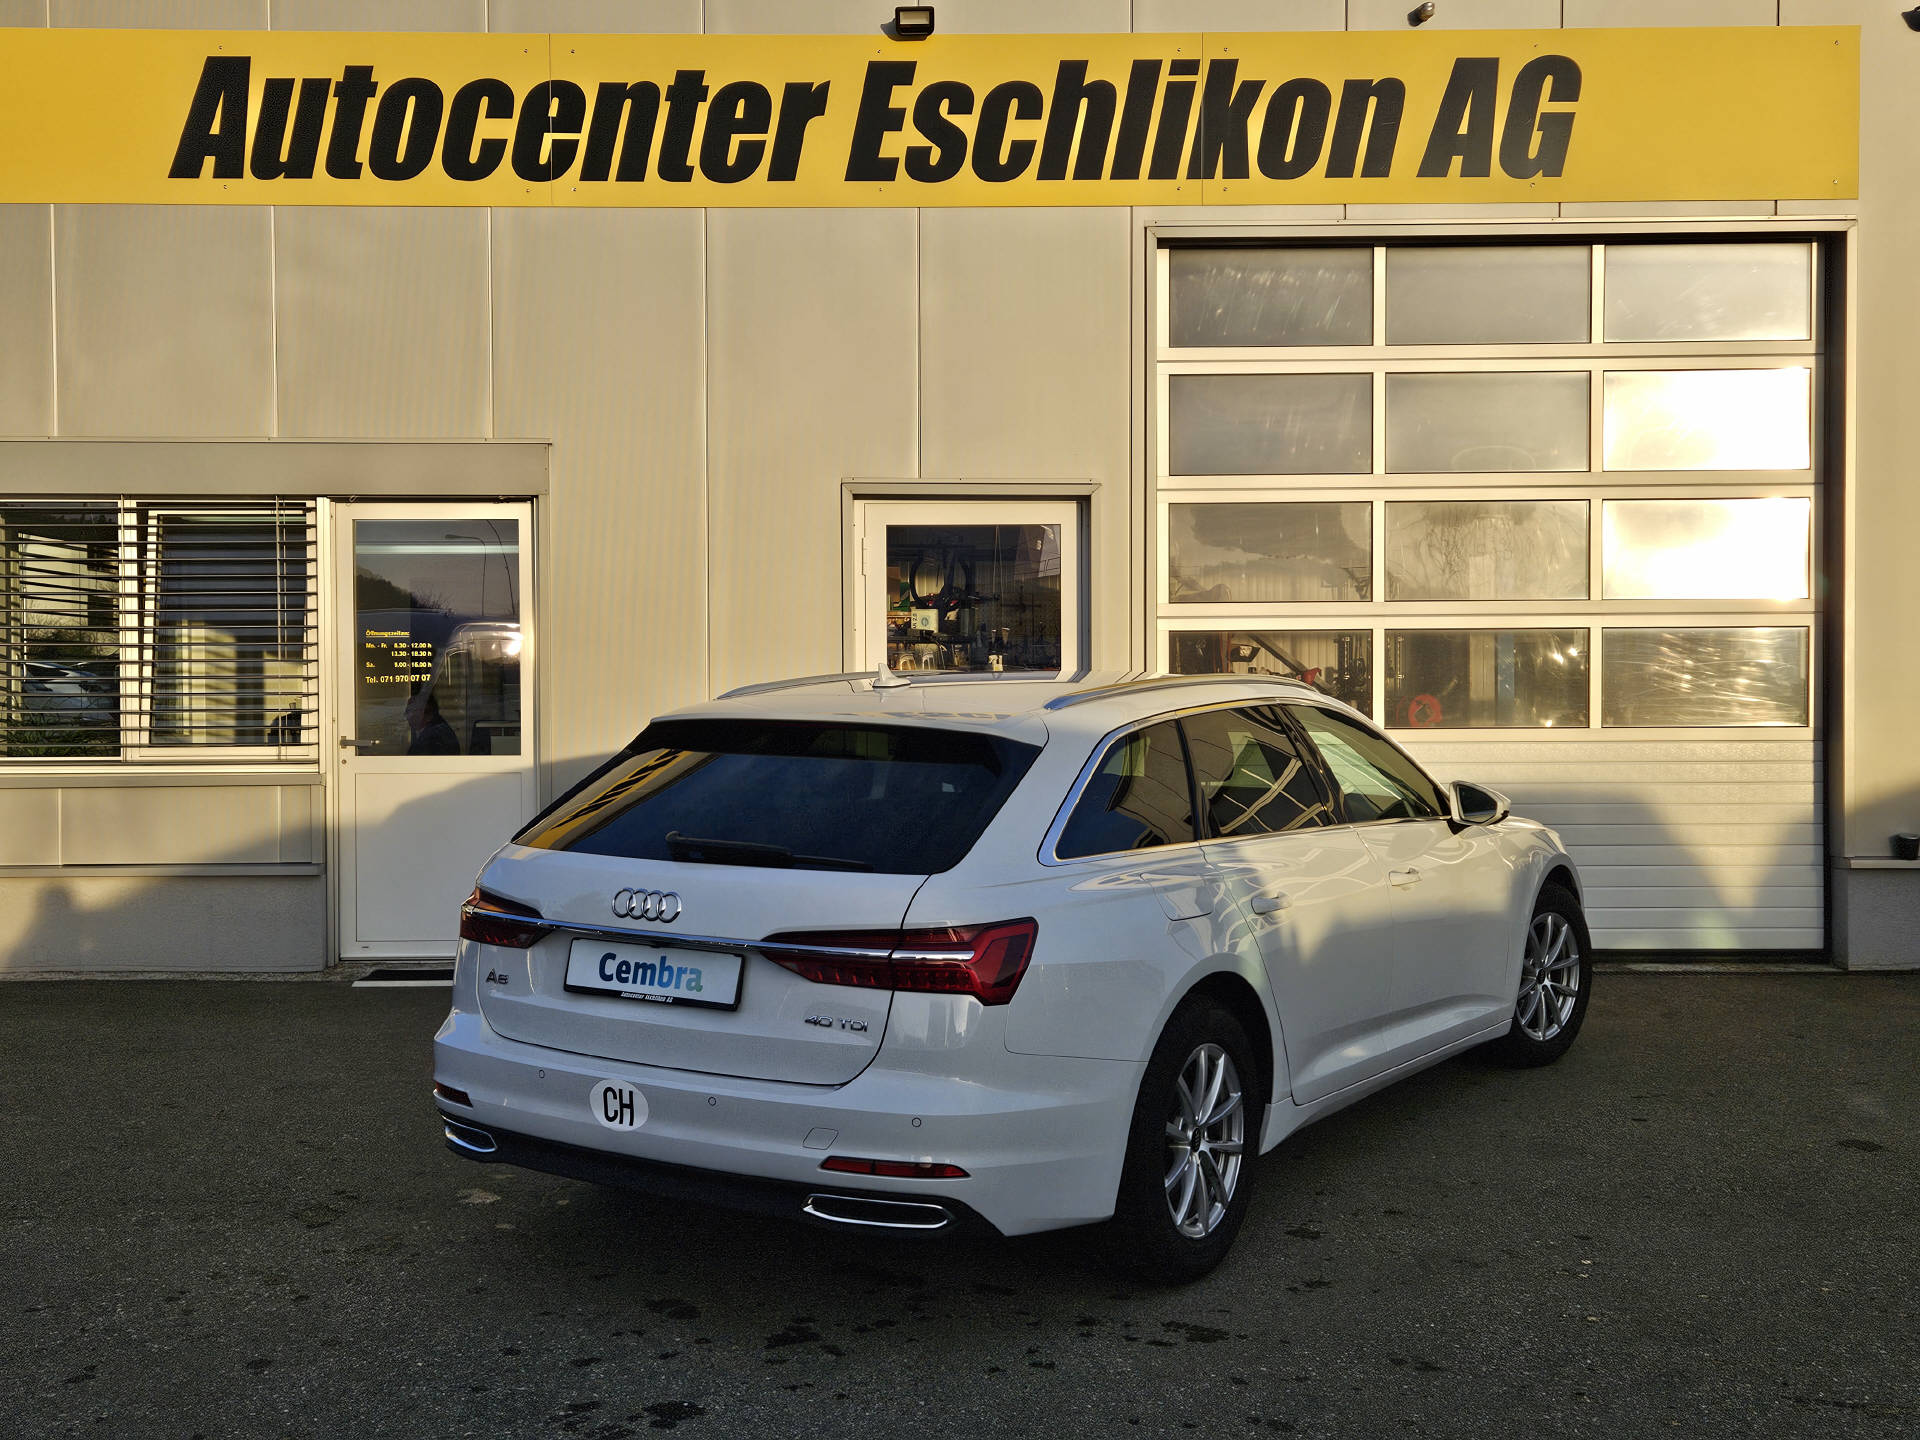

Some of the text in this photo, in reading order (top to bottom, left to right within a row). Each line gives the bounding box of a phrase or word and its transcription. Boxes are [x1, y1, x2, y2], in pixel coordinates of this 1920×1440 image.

[168, 54, 1583, 184] Autocenter Eschlikon AG
[365, 675, 379, 684] Tel.
[380, 675, 393, 683] 071
[395, 675, 409, 683] 970
[421, 673, 431, 681] 07
[486, 967, 509, 985] A6
[599, 952, 703, 993] Cembra
[804, 1015, 868, 1033] 40 TDI
[603, 1087, 634, 1127] CH
